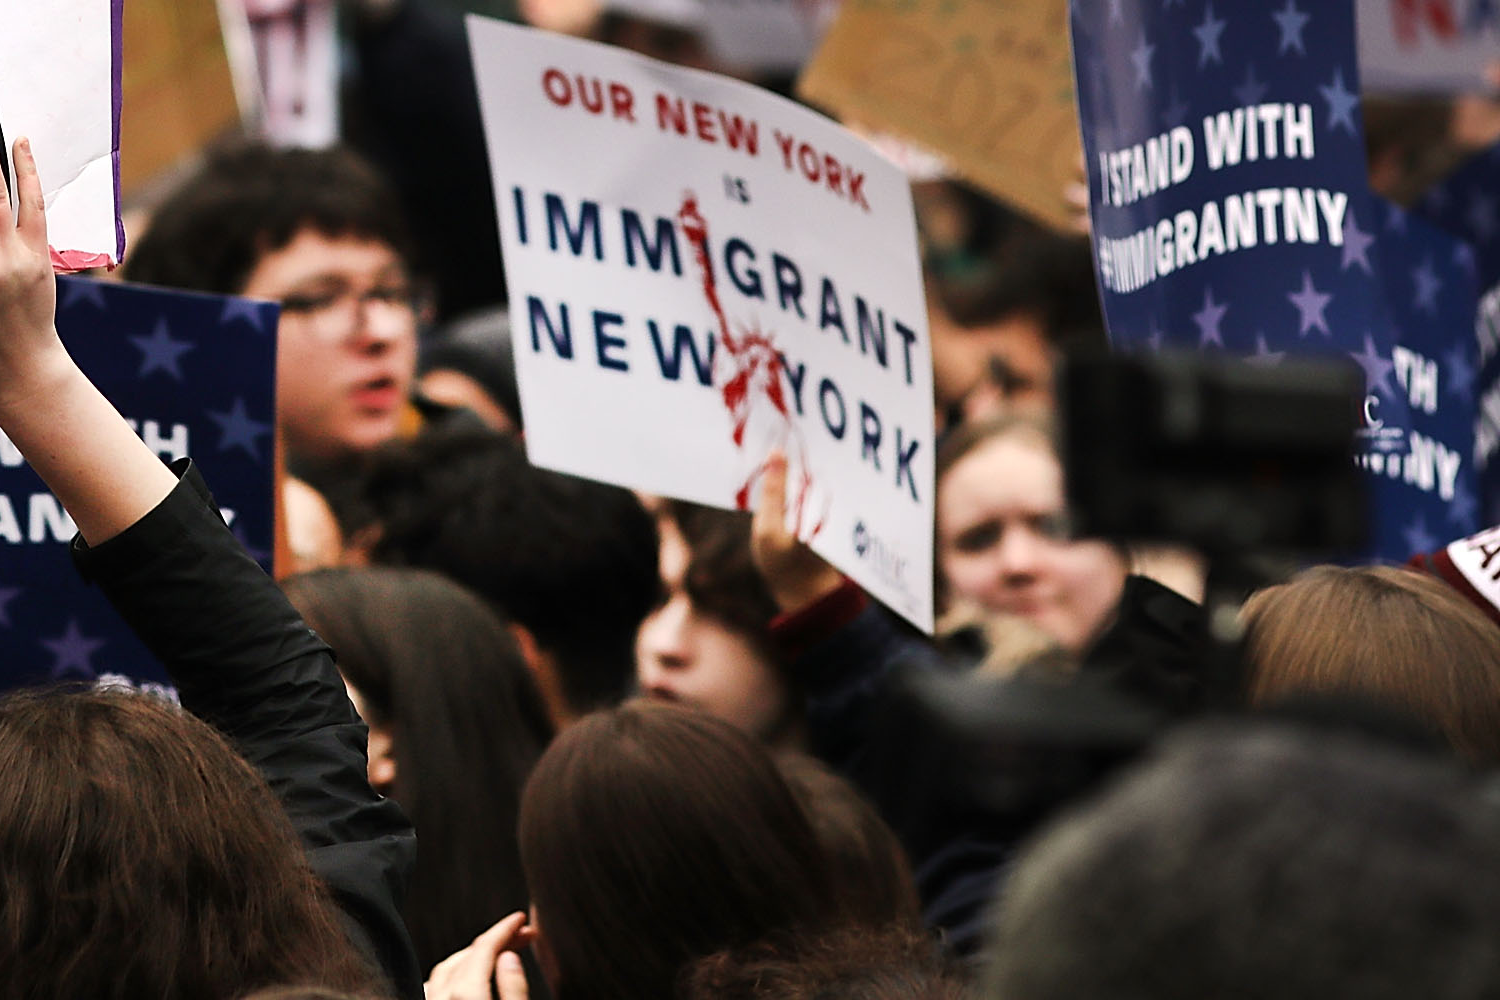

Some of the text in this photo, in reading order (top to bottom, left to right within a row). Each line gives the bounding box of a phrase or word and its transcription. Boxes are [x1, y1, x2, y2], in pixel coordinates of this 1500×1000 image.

[541, 68, 872, 214] OUR NEW YORK
[723, 174, 750, 206] IS
[1099, 102, 1315, 208] I STAND WITH
[512, 185, 919, 386] IMMIGRANT
[527, 295, 920, 503] NEW YORK
